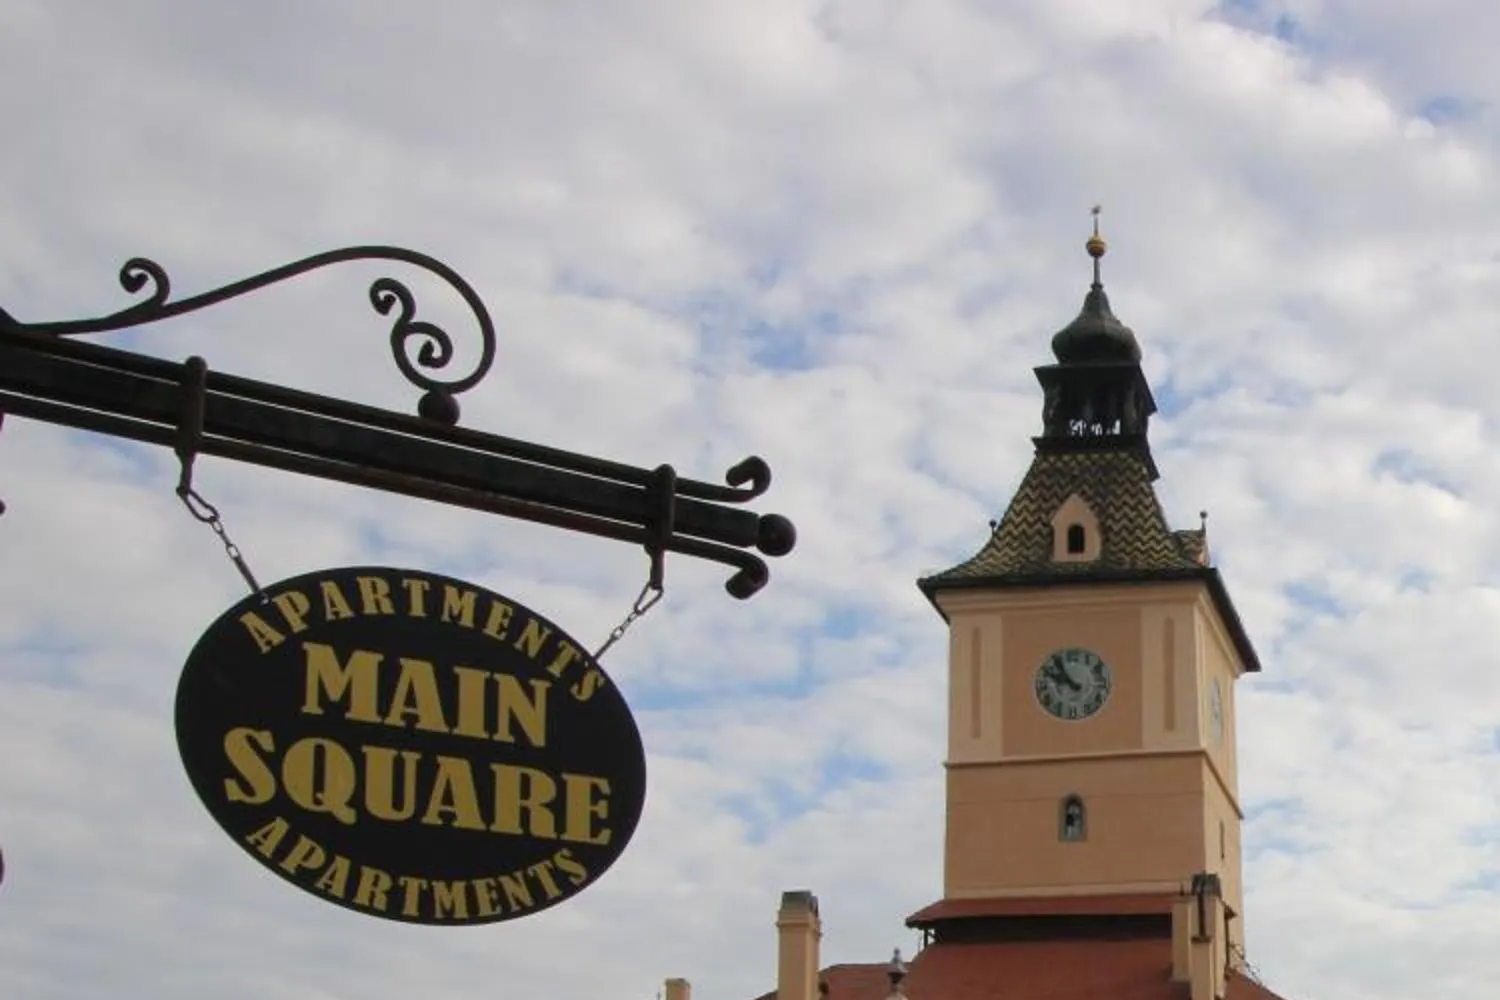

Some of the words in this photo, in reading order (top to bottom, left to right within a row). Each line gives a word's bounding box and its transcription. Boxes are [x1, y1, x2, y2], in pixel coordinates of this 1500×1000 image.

[239, 576, 605, 702] APARTMENTS
[300, 642, 552, 748] MAIN
[223, 726, 612, 846] SQUARE
[246, 817, 587, 920] APARTMENTS
